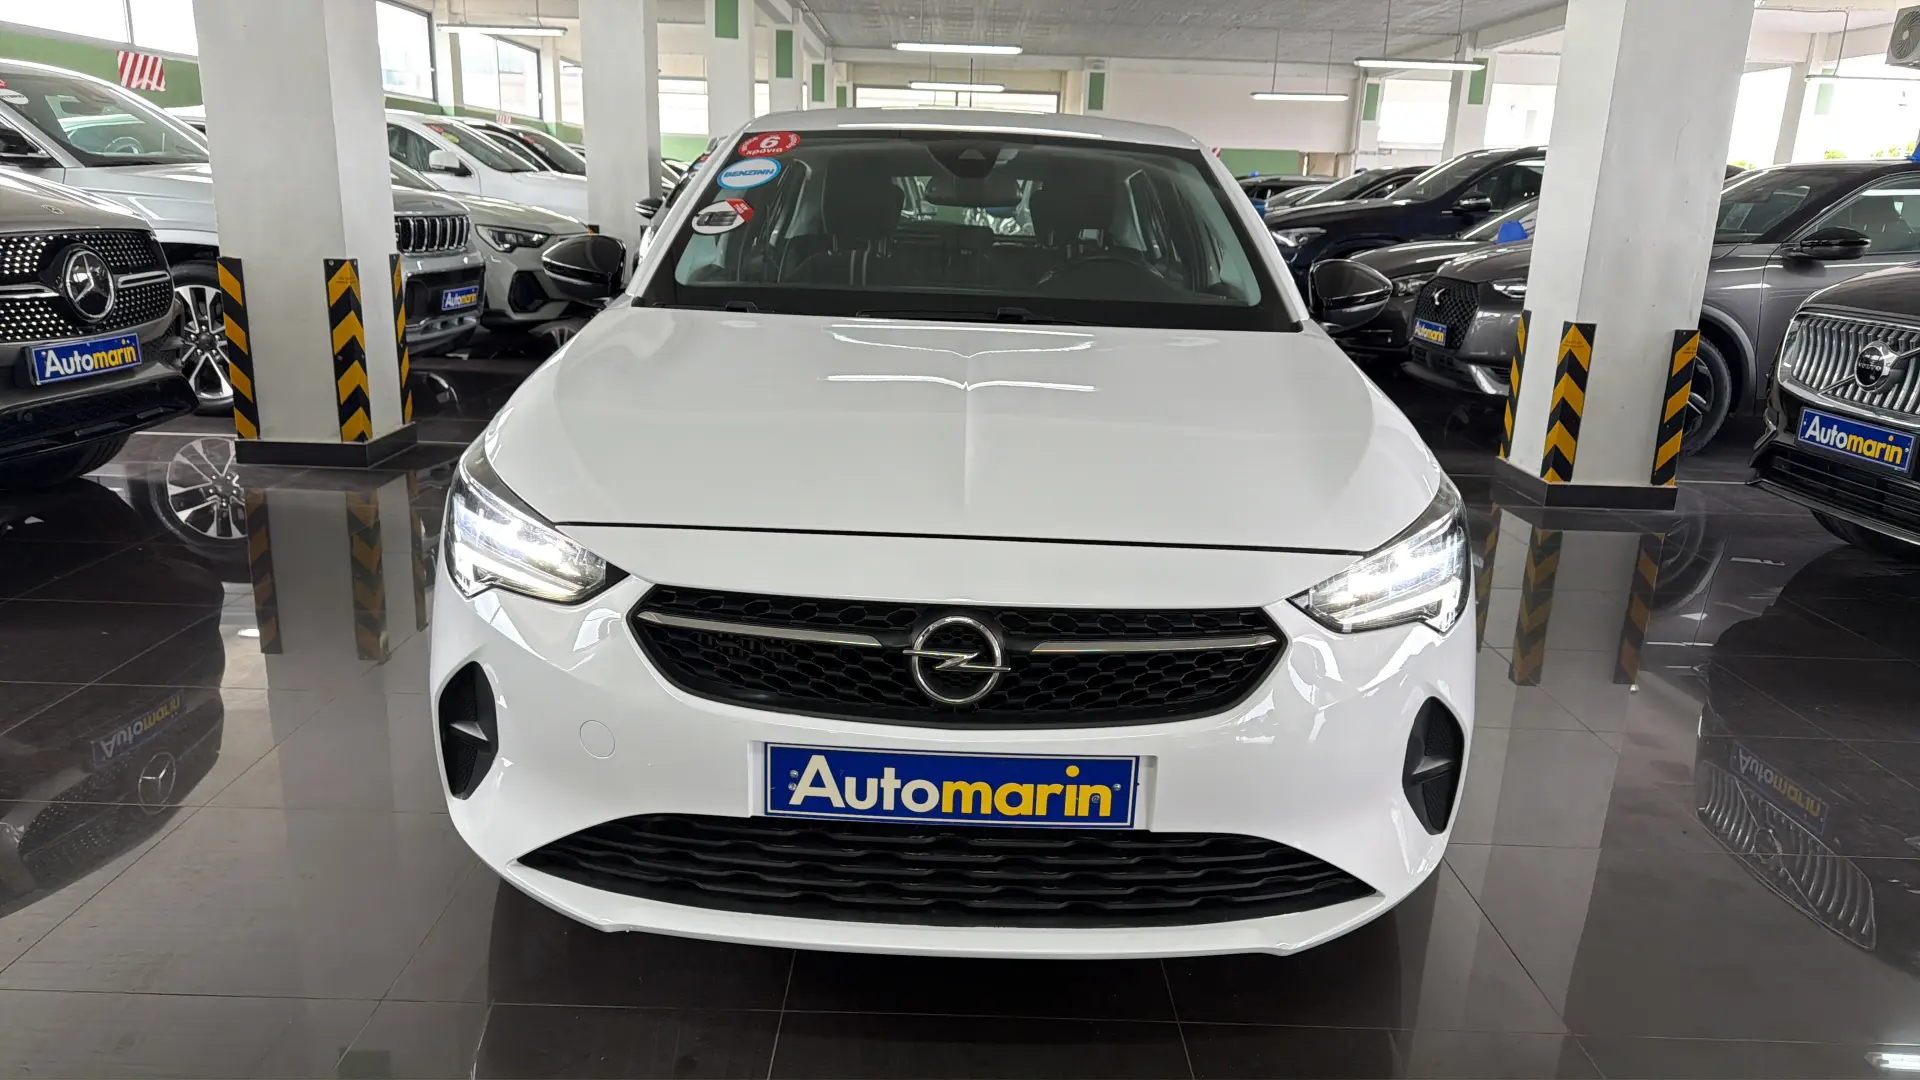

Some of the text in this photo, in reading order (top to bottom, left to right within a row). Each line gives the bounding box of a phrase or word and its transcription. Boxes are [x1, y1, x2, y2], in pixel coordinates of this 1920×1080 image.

[759, 135, 781, 149] 6
[44, 338, 137, 378] Automarin
[1804, 415, 1903, 465] Automarin
[789, 754, 1113, 817] Automarin
